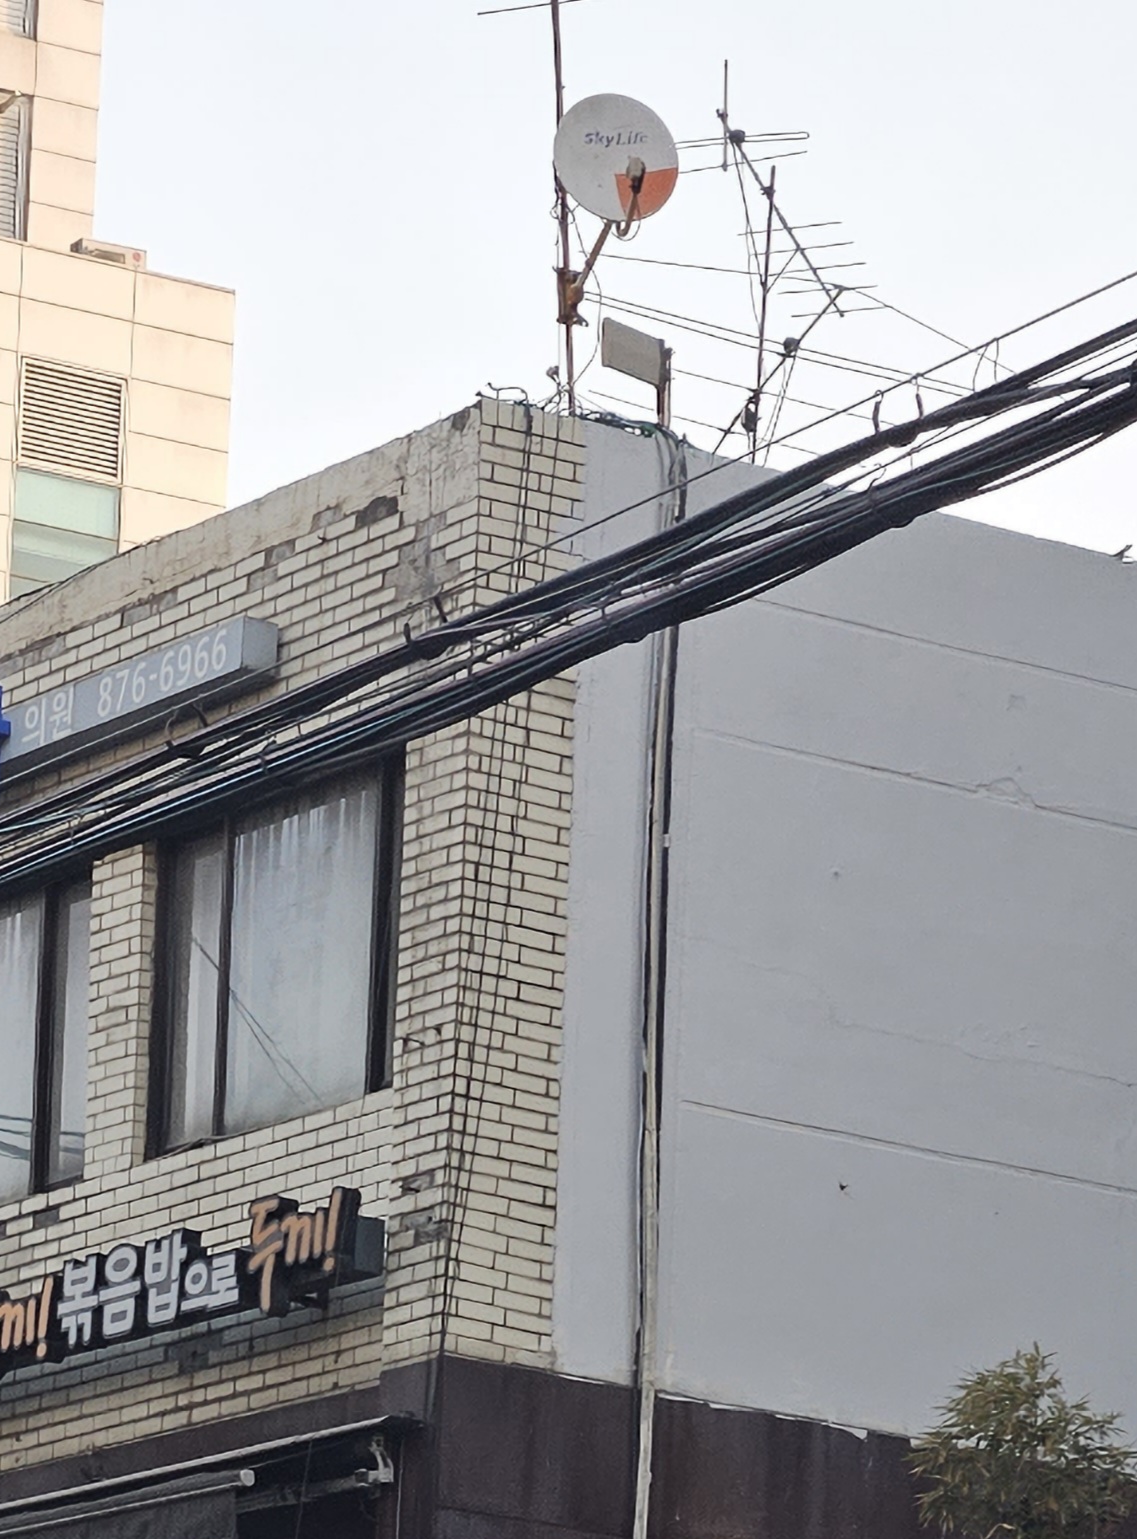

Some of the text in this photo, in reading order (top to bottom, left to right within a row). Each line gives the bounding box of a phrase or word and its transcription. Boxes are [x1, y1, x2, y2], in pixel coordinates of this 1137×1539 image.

[21, 684, 75, 746] 의원
[96, 629, 228, 718] 876-6966
[57, 1230, 240, 1349] 볶음밥으로
